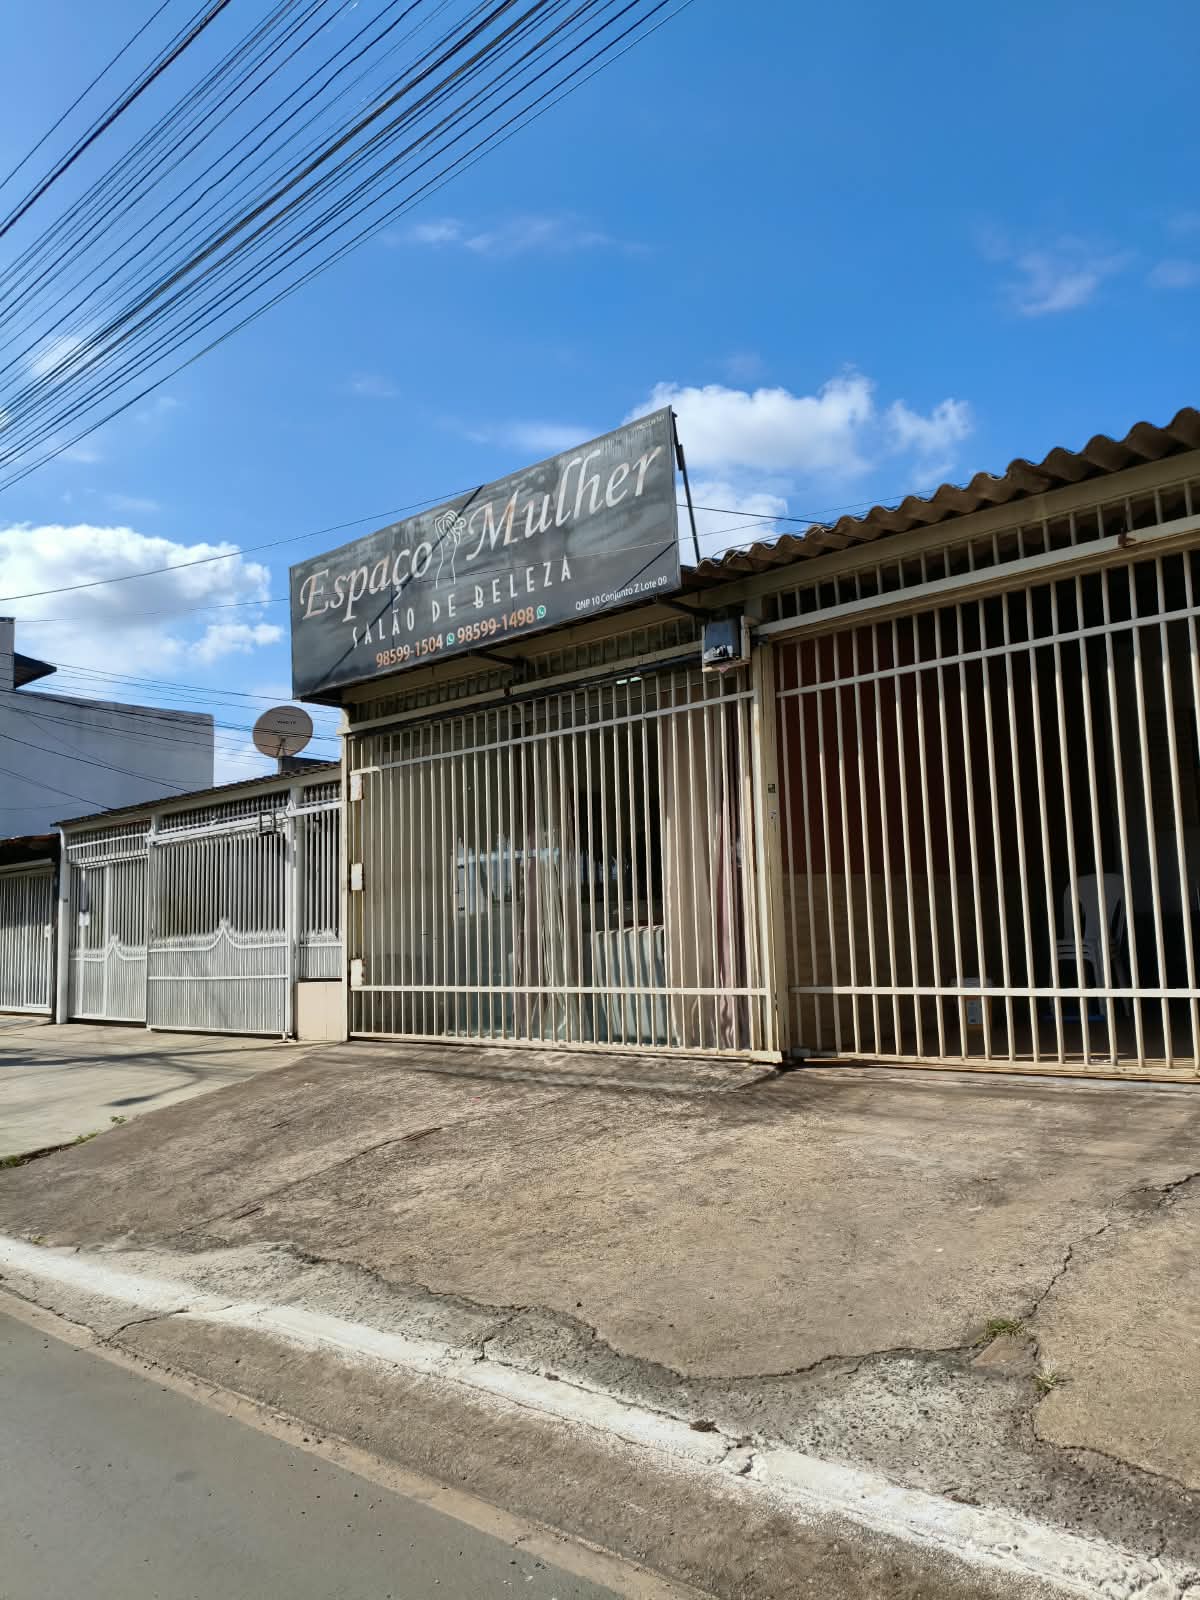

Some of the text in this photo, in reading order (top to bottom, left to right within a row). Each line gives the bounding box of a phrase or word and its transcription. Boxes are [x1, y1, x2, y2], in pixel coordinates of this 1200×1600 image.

[300, 446, 663, 622] Espaço Mulher
[352, 554, 571, 648] SALÃO DE BELEZA
[575, 575, 668, 611] QNP 10 Conjunto Z Lote 09
[376, 606, 535, 668] 98599-1504 98599-1498
